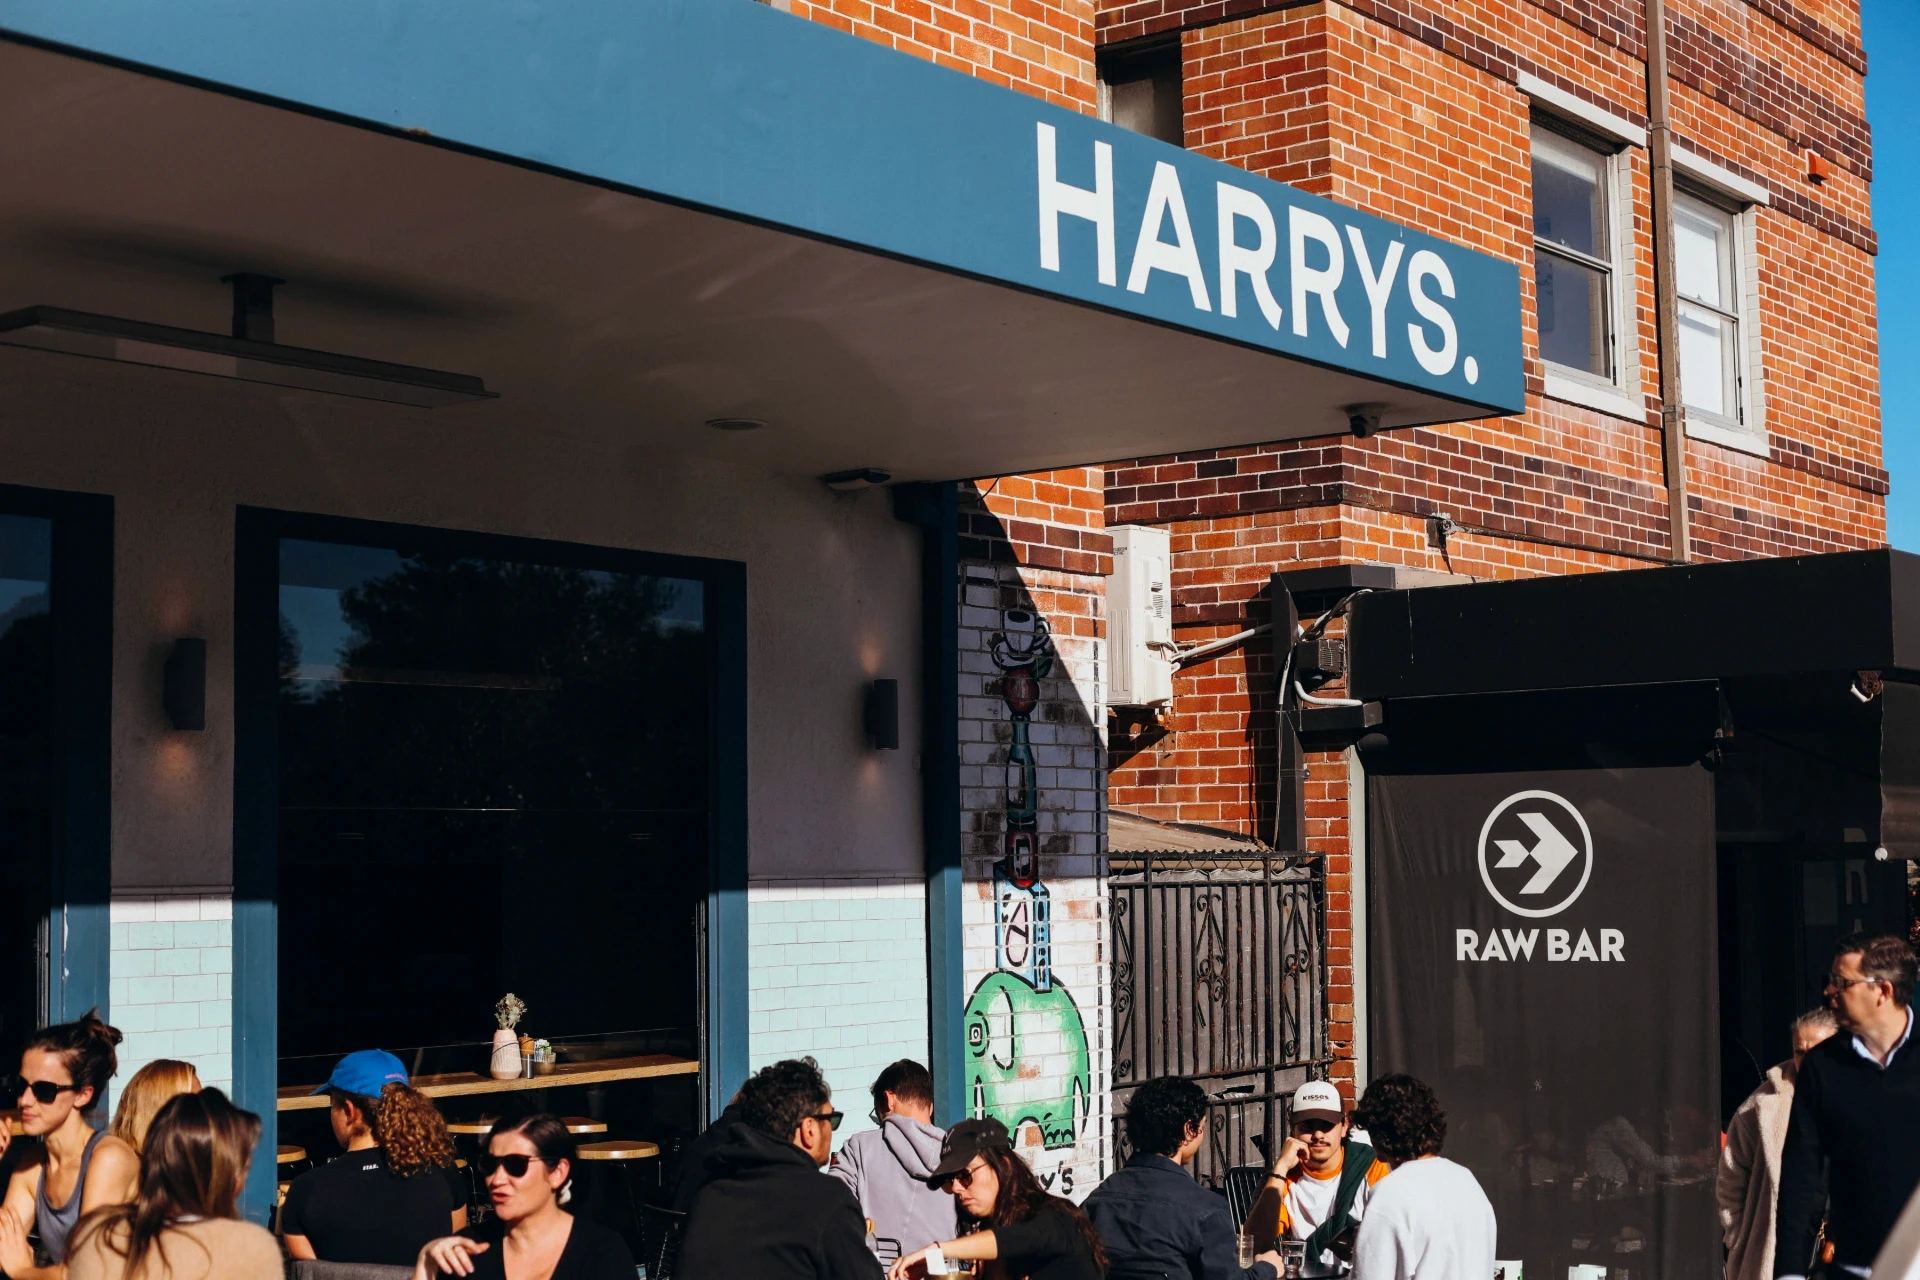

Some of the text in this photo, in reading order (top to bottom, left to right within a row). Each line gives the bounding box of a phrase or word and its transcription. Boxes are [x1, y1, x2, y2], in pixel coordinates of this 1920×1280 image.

[1036, 121, 1479, 386] HARRYS.
[1456, 927, 1626, 962] RAW BAR
